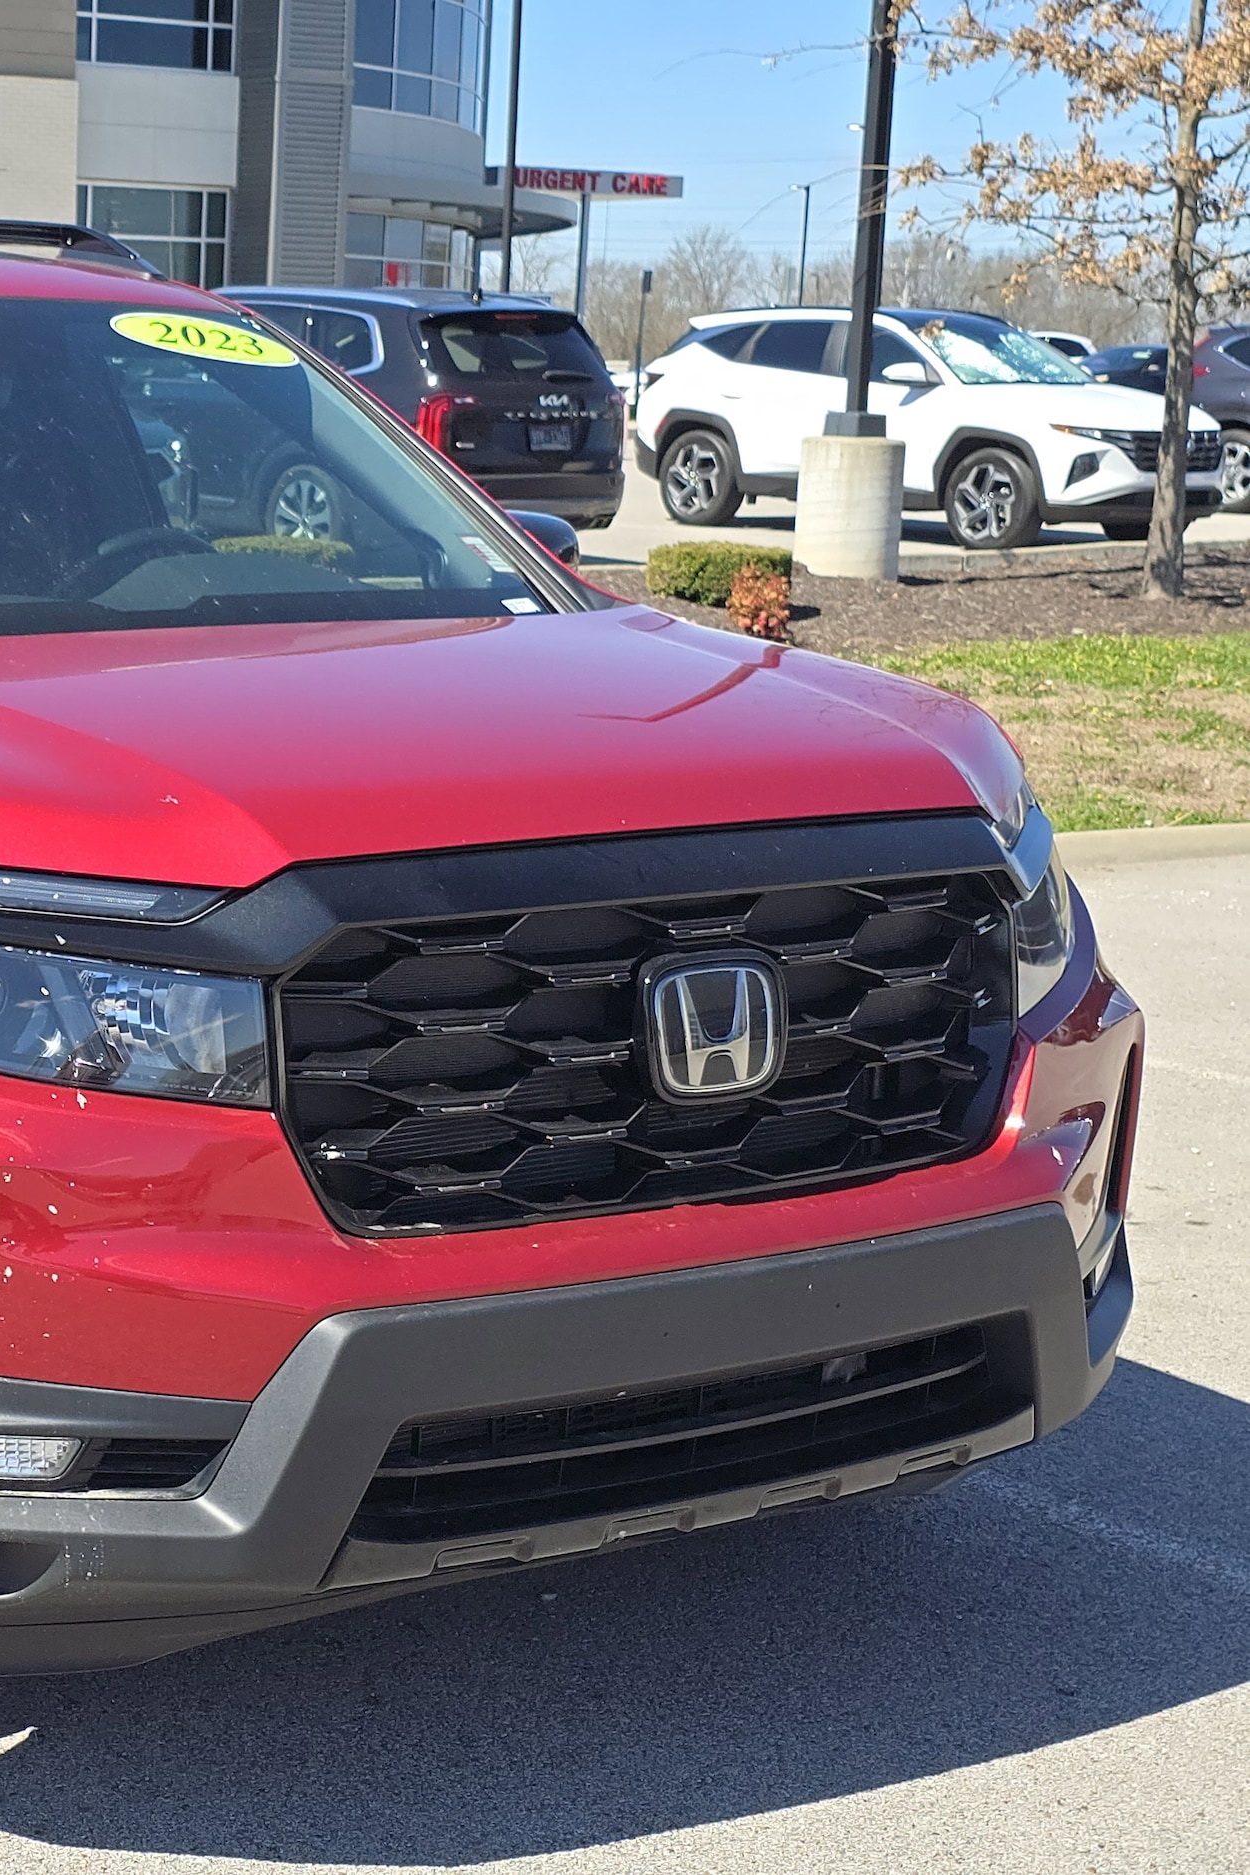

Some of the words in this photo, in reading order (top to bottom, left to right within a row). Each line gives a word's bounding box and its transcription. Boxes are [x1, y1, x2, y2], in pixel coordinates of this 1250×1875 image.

[514, 166, 601, 192] URGENT
[612, 174, 668, 195] CARE
[149, 321, 263, 356] 2023
